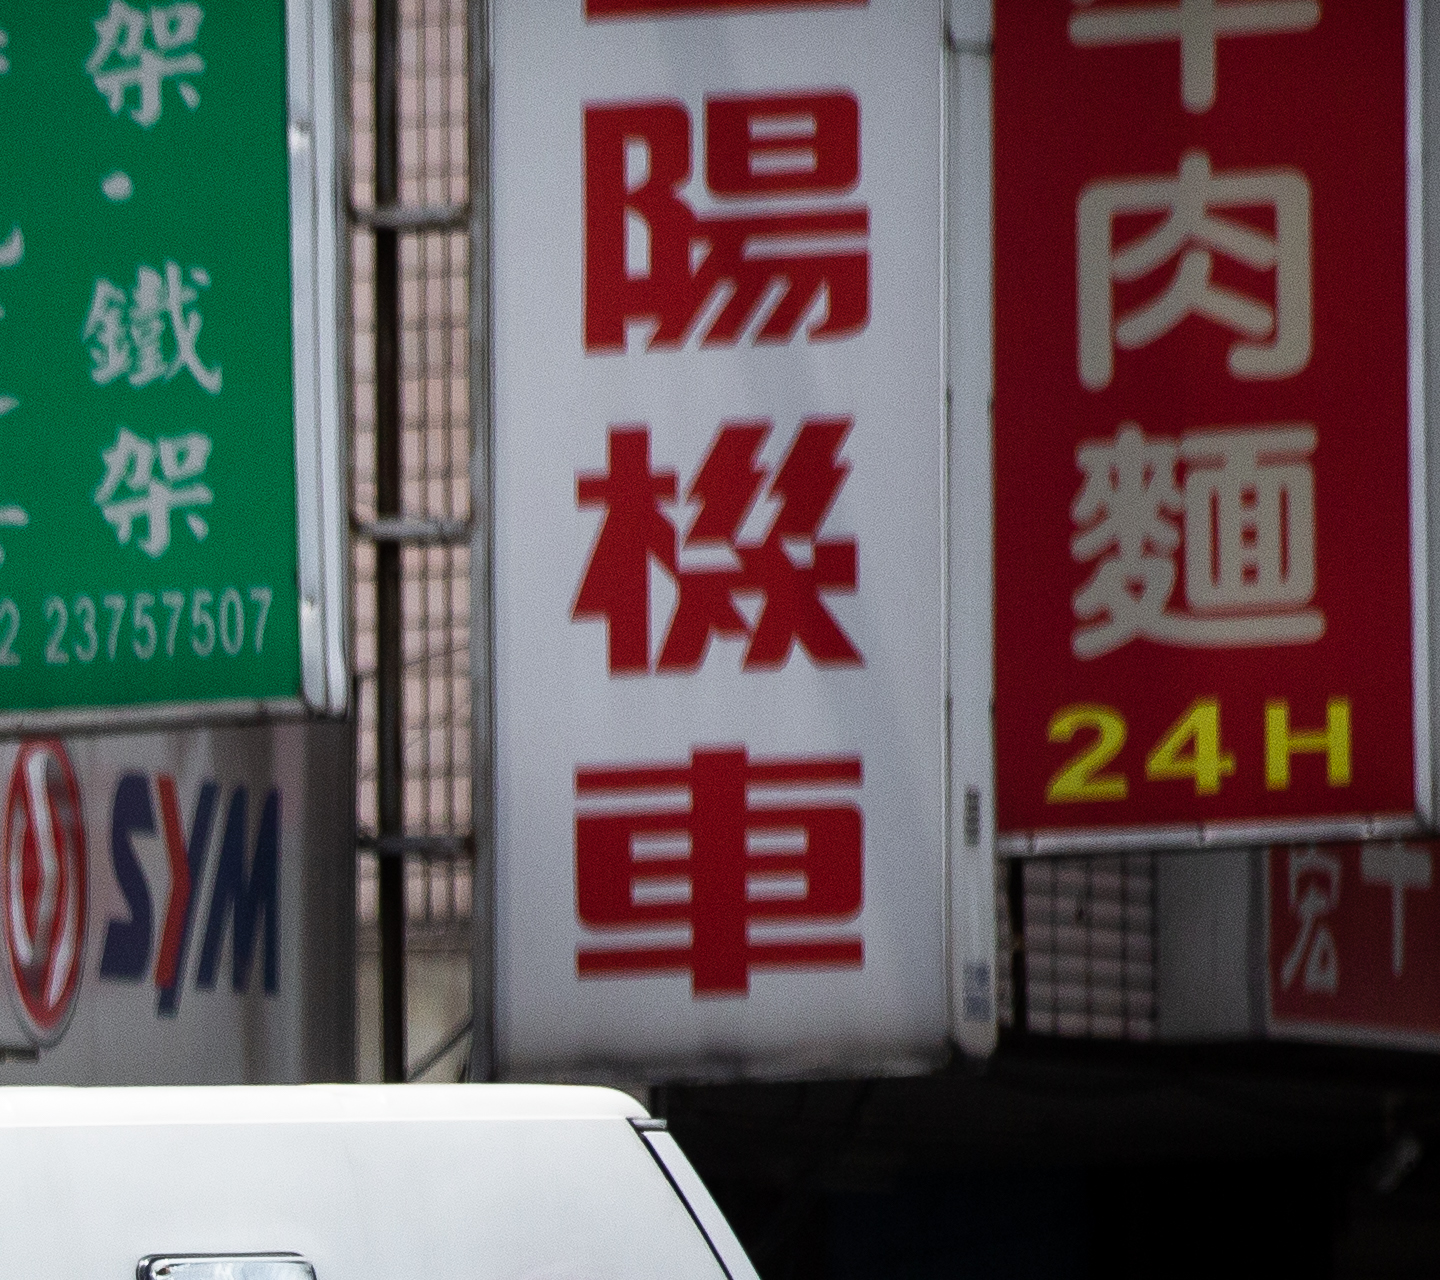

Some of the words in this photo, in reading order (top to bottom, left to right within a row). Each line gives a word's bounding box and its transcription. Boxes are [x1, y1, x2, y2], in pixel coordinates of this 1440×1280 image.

[570, 0, 872, 998] 陽機車
[46, 588, 274, 664] 23757507
[101, 773, 280, 1017] SYM
